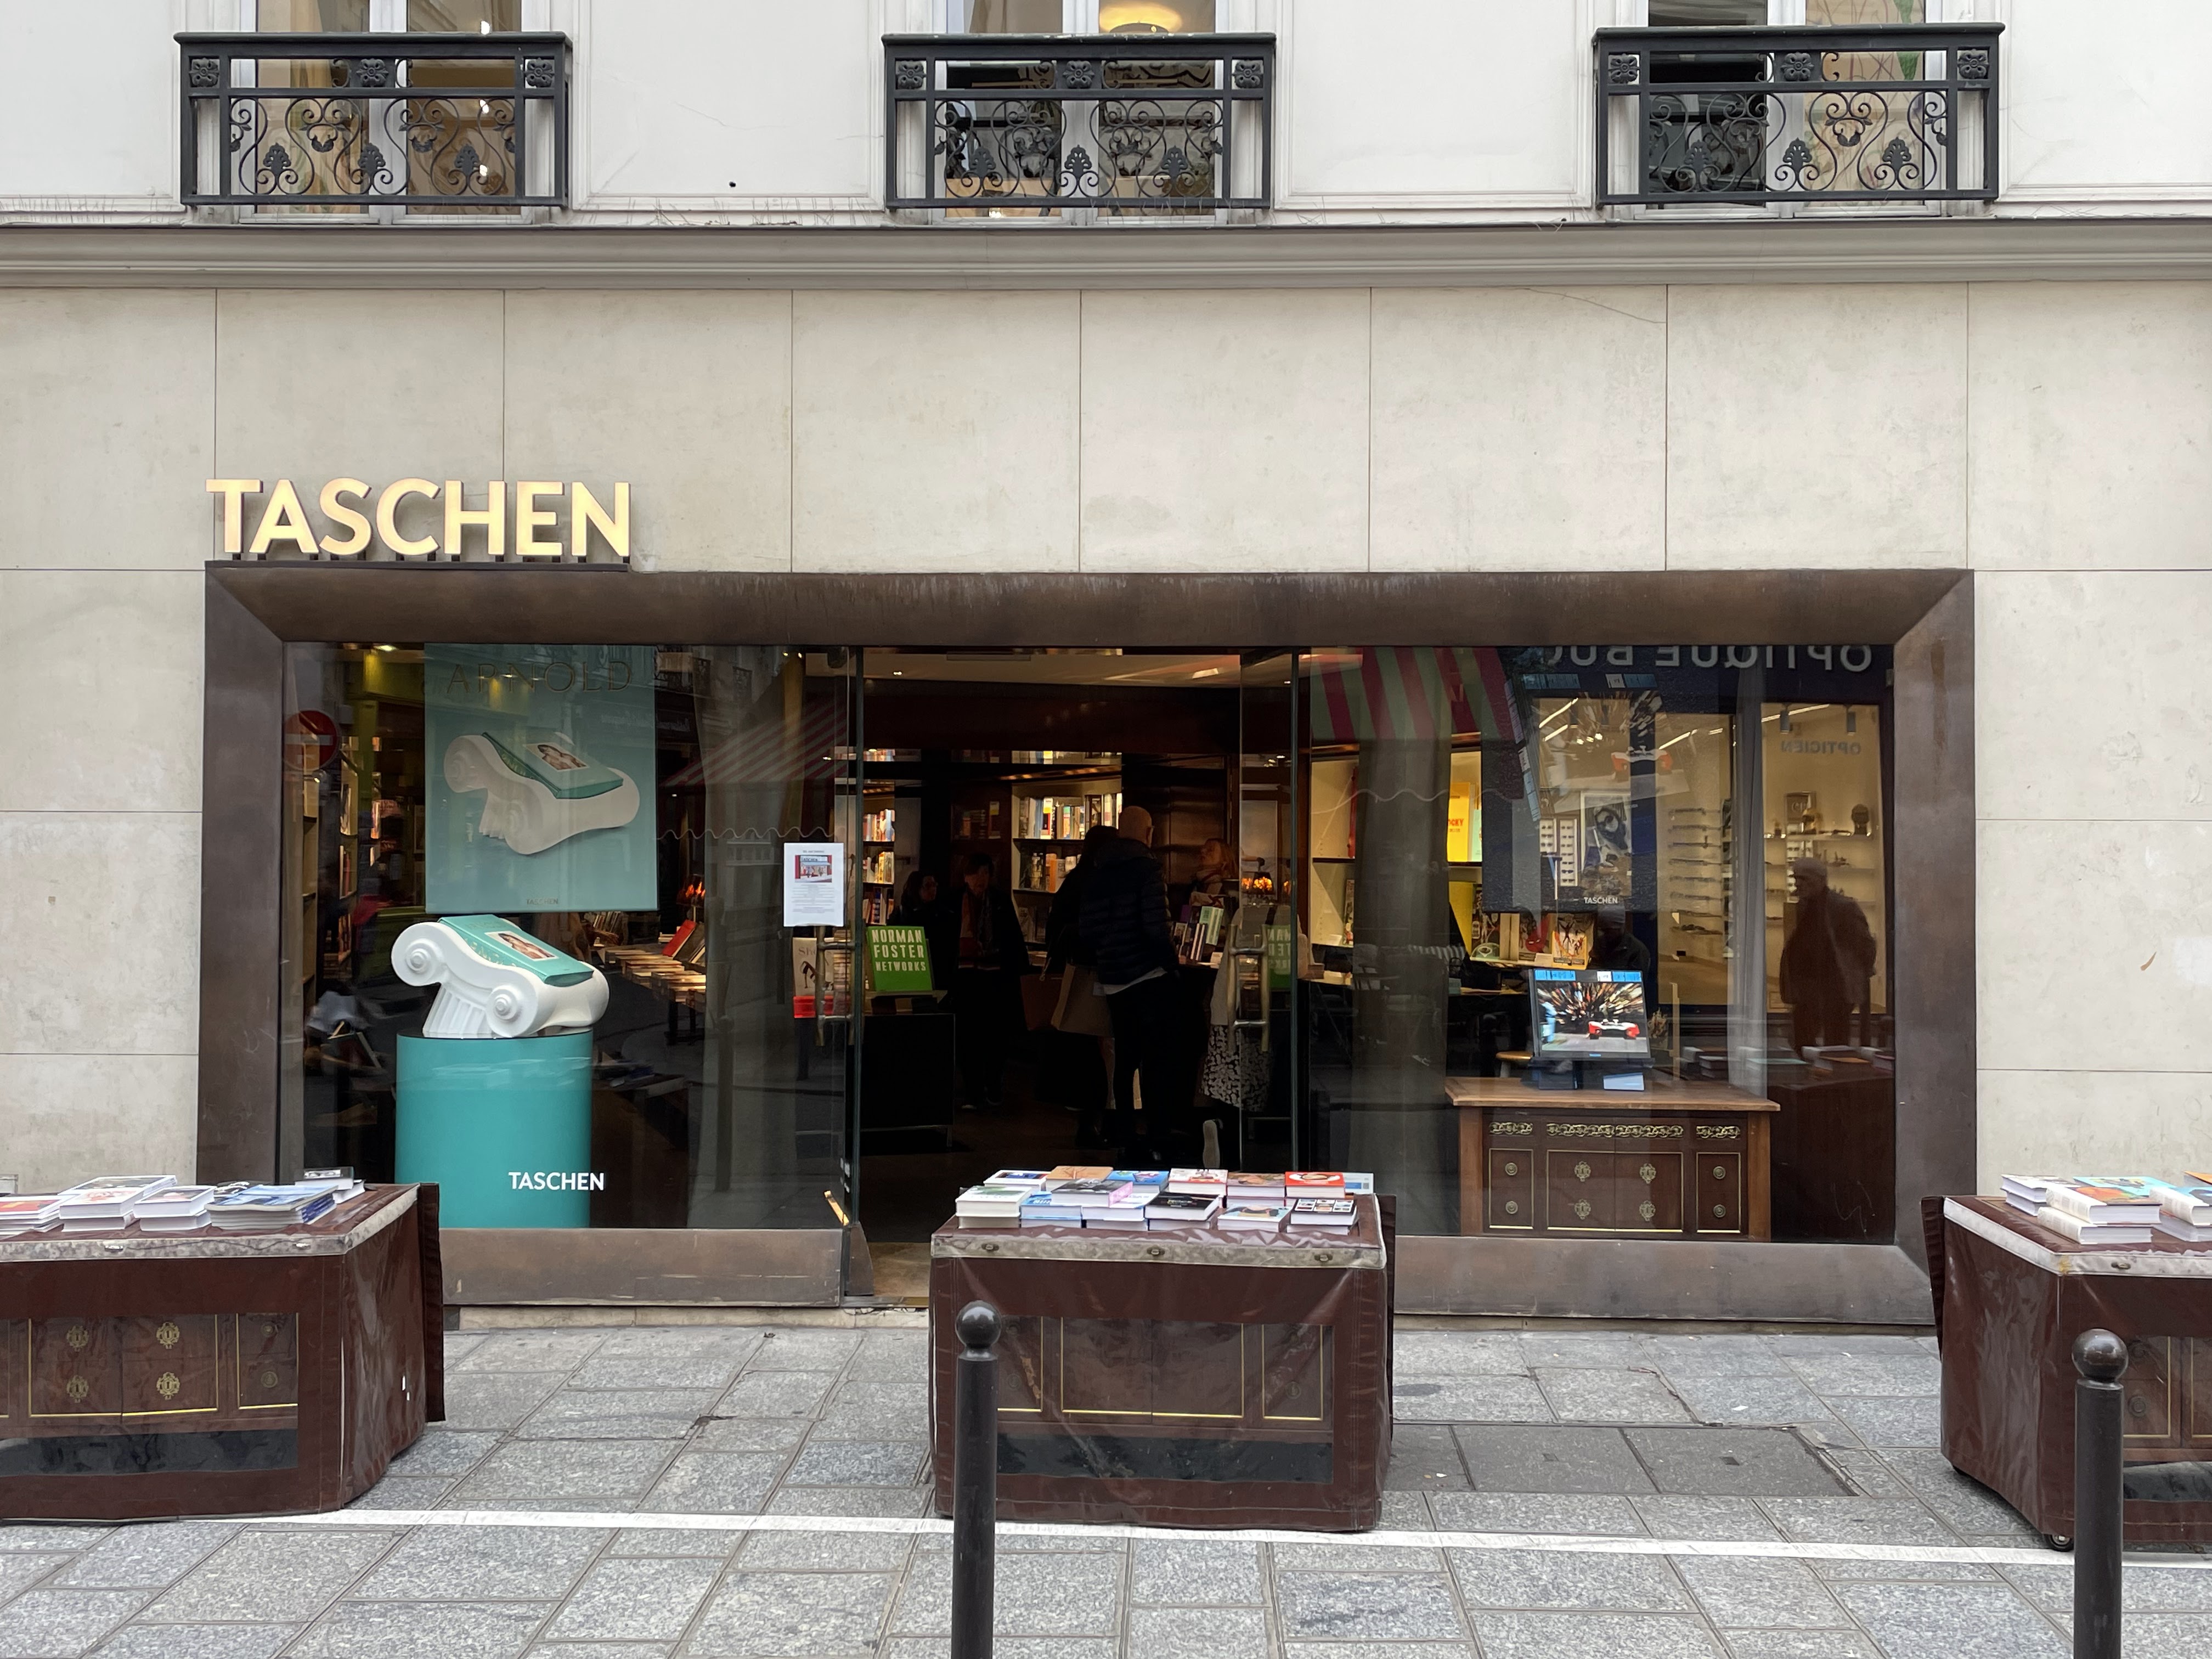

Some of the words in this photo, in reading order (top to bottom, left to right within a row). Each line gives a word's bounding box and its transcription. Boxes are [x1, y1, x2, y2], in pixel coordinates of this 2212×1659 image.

[205, 477, 631, 557] TASCHEN
[447, 661, 630, 693] ARNOLD
[871, 929, 922, 943] NORMAN
[798, 947, 832, 956] Shs
[873, 944, 924, 958] FOSTER
[875, 961, 926, 972] NETWORKS
[508, 1172, 605, 1190] TASCHEN
